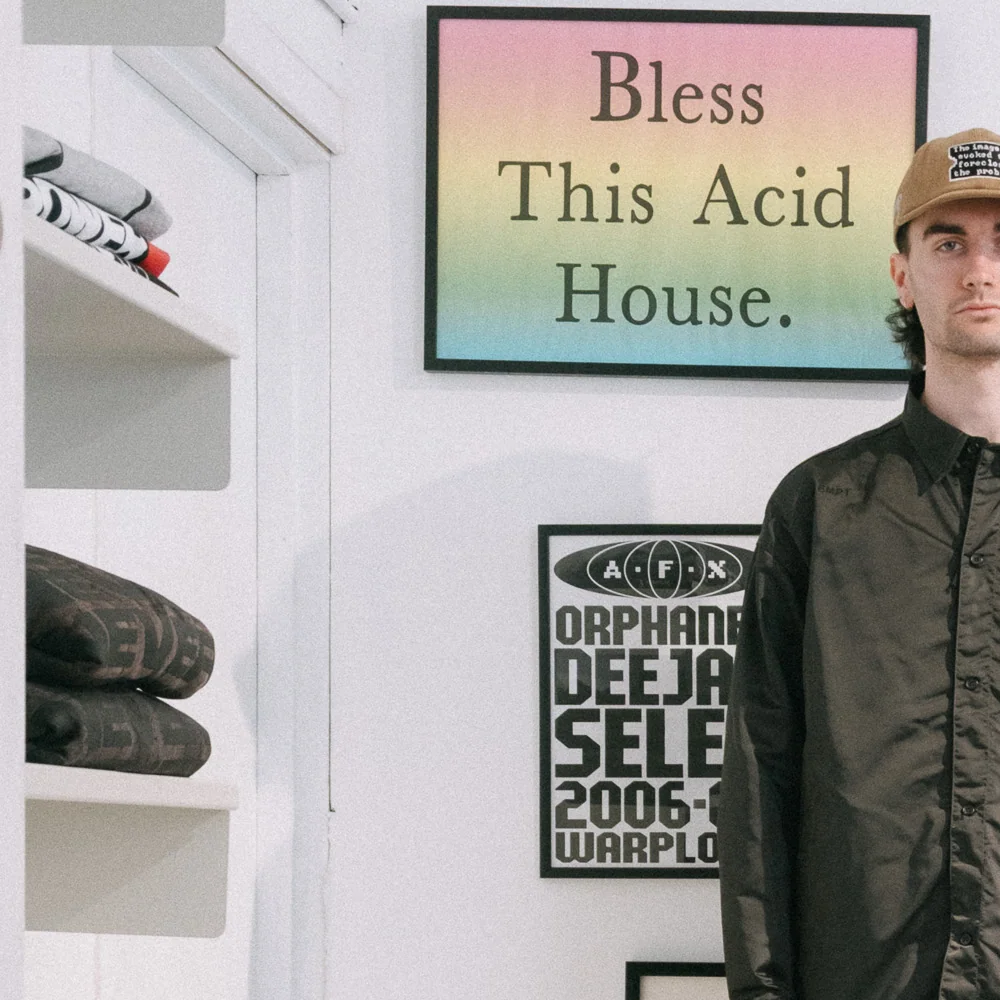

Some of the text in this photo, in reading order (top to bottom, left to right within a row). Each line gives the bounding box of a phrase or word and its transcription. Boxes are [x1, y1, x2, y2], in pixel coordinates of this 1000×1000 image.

[590, 50, 765, 125] Bless
[953, 145, 970, 153] The
[972, 143, 1000, 152] image
[954, 169, 971, 177] the
[958, 151, 993, 160] evoked
[498, 161, 854, 229] This Acid
[555, 262, 792, 328] House.
[554, 648, 734, 706] DEEJA
[554, 708, 725, 778] SELE
[555, 832, 720, 863] WARPLO
